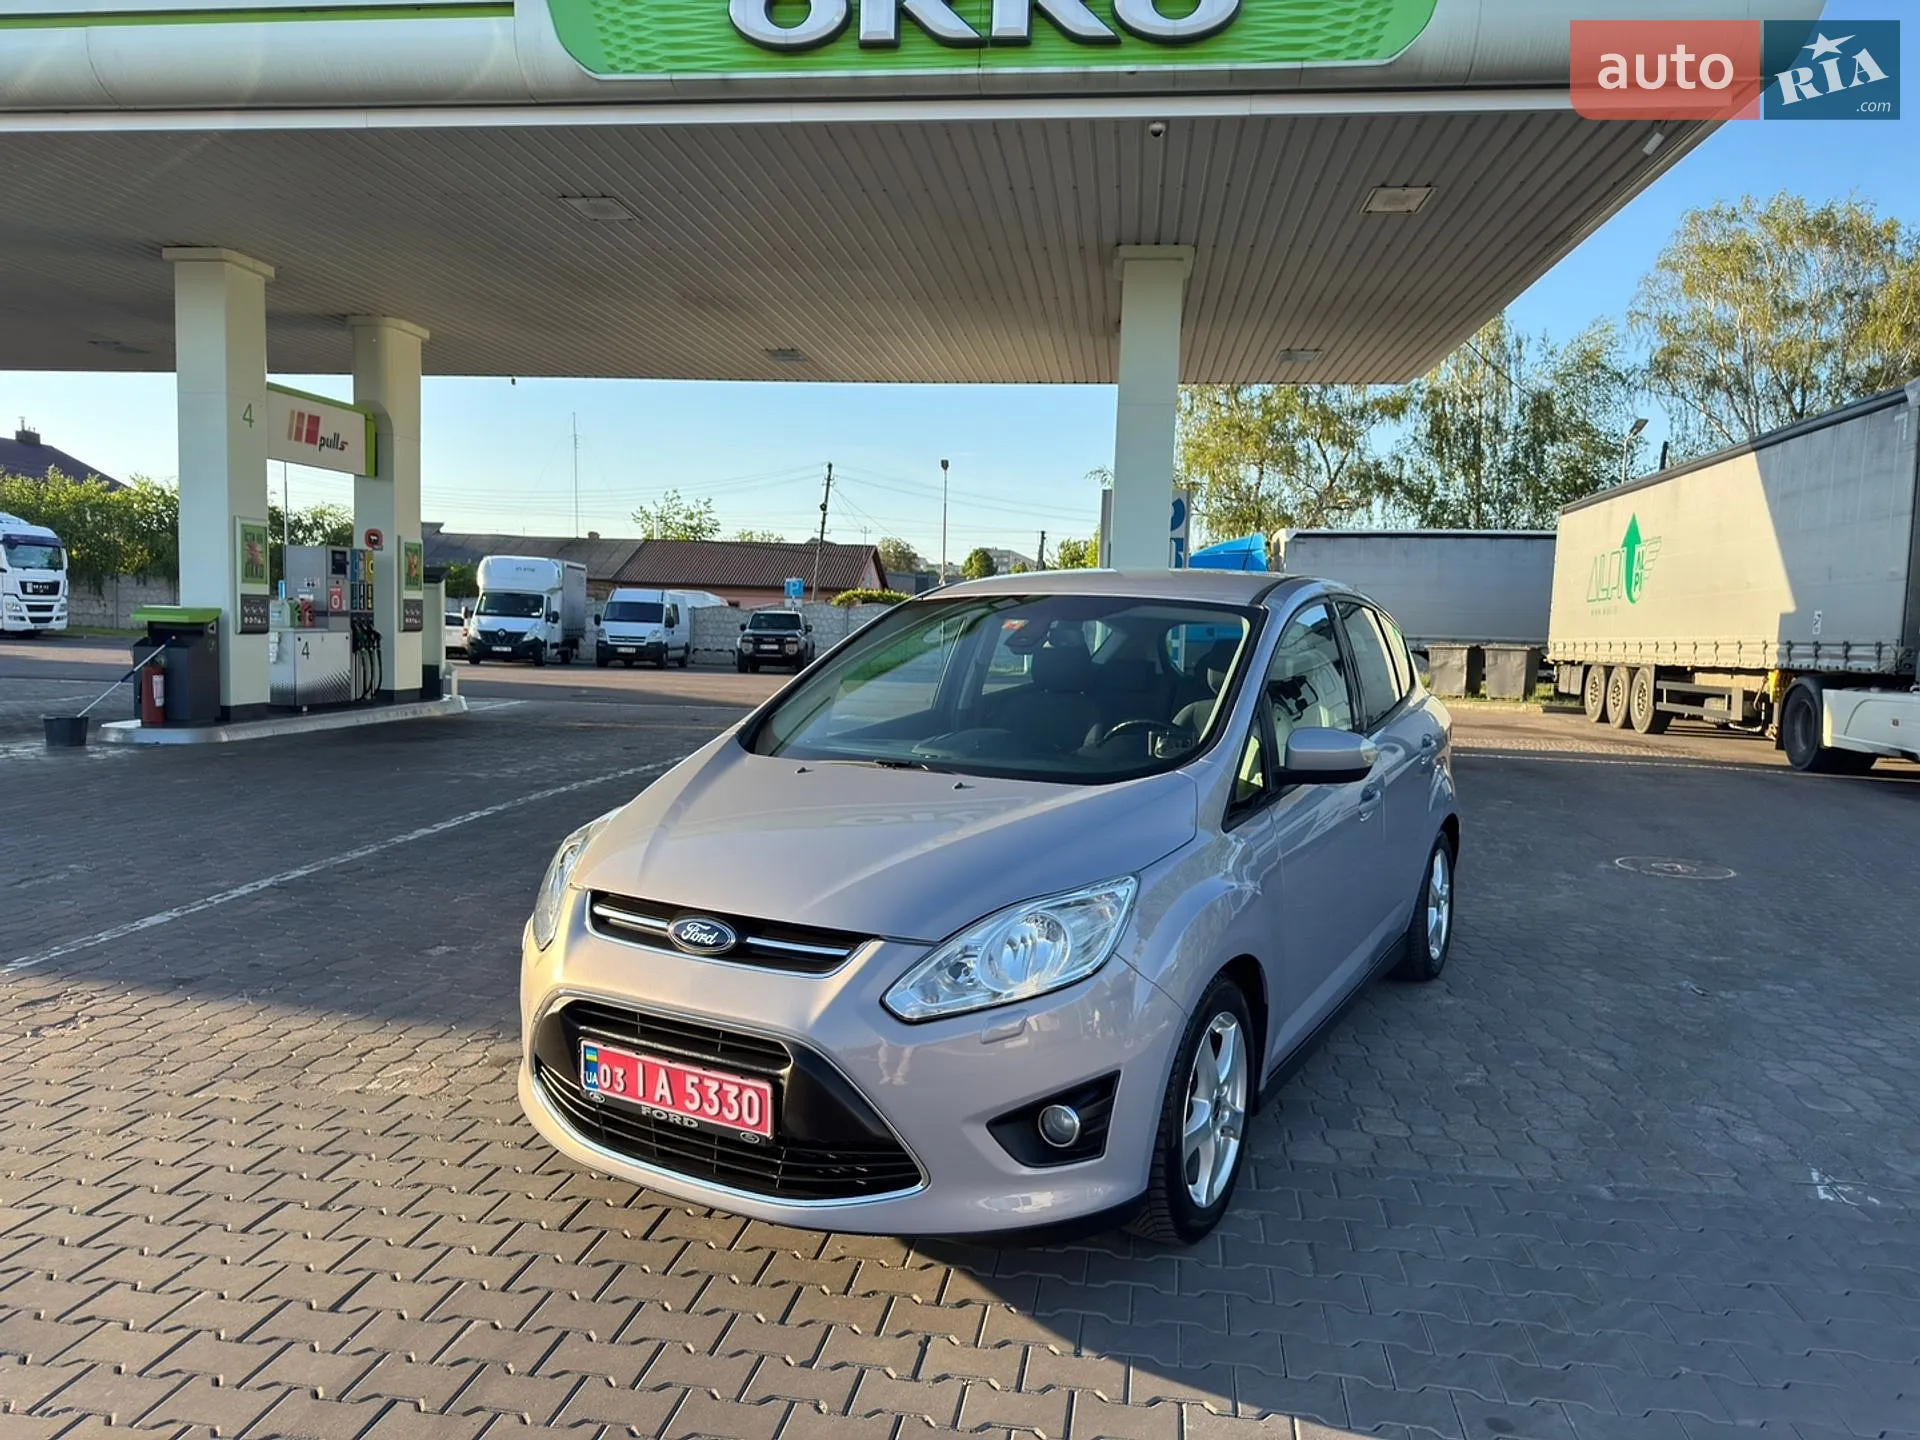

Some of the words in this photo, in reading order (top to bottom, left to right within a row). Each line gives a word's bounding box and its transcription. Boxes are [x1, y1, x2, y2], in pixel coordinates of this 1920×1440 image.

[242, 403, 255, 429] 4
[319, 432, 349, 452] pulls
[301, 641, 310, 660] 4
[681, 922, 719, 945] Ford
[585, 1070, 599, 1084] UA
[600, 1063, 627, 1093] 03
[684, 1074, 761, 1126] 5330
[640, 1106, 699, 1128] FORD
